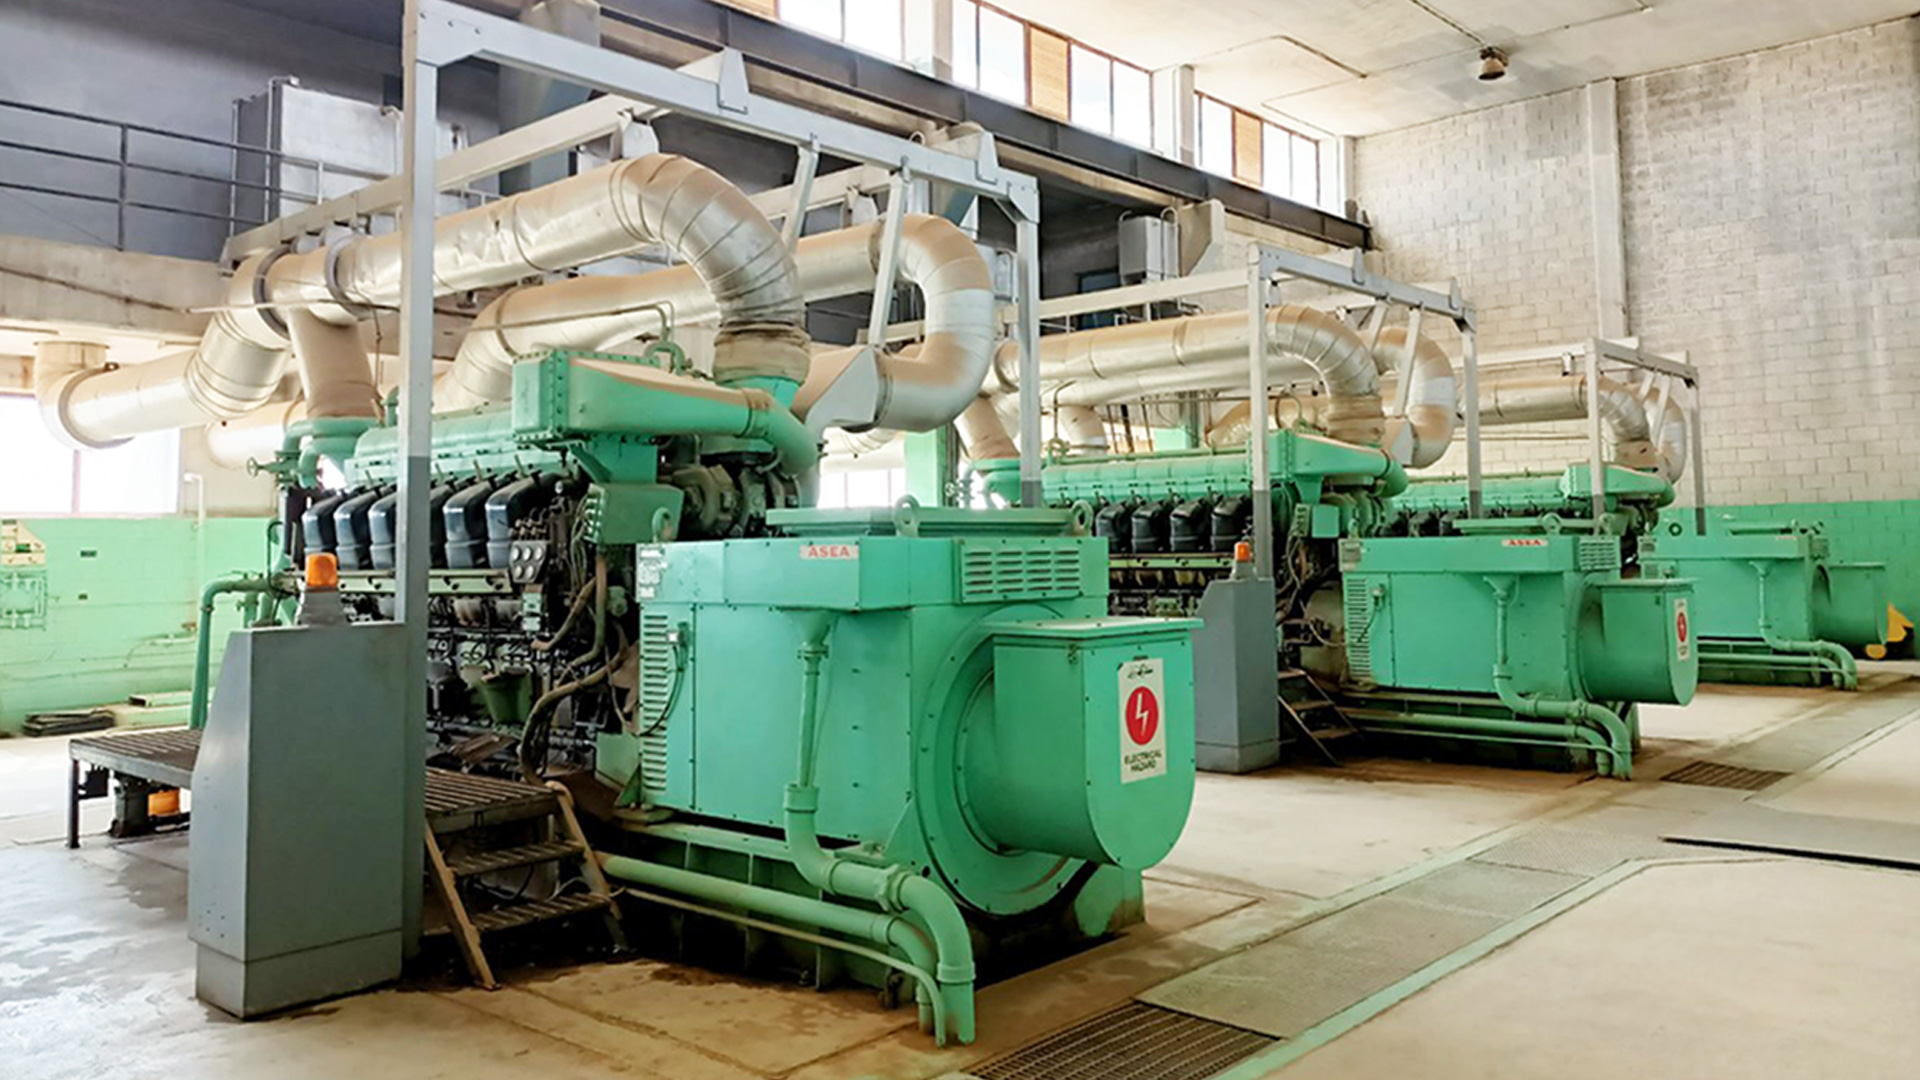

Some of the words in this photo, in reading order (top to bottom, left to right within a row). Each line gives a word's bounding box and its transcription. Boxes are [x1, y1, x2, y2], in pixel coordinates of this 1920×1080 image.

[808, 546, 850, 557] ASEA
[1124, 750, 1162, 764] ELECTRICAL
[1131, 759, 1157, 771] HAZARD
